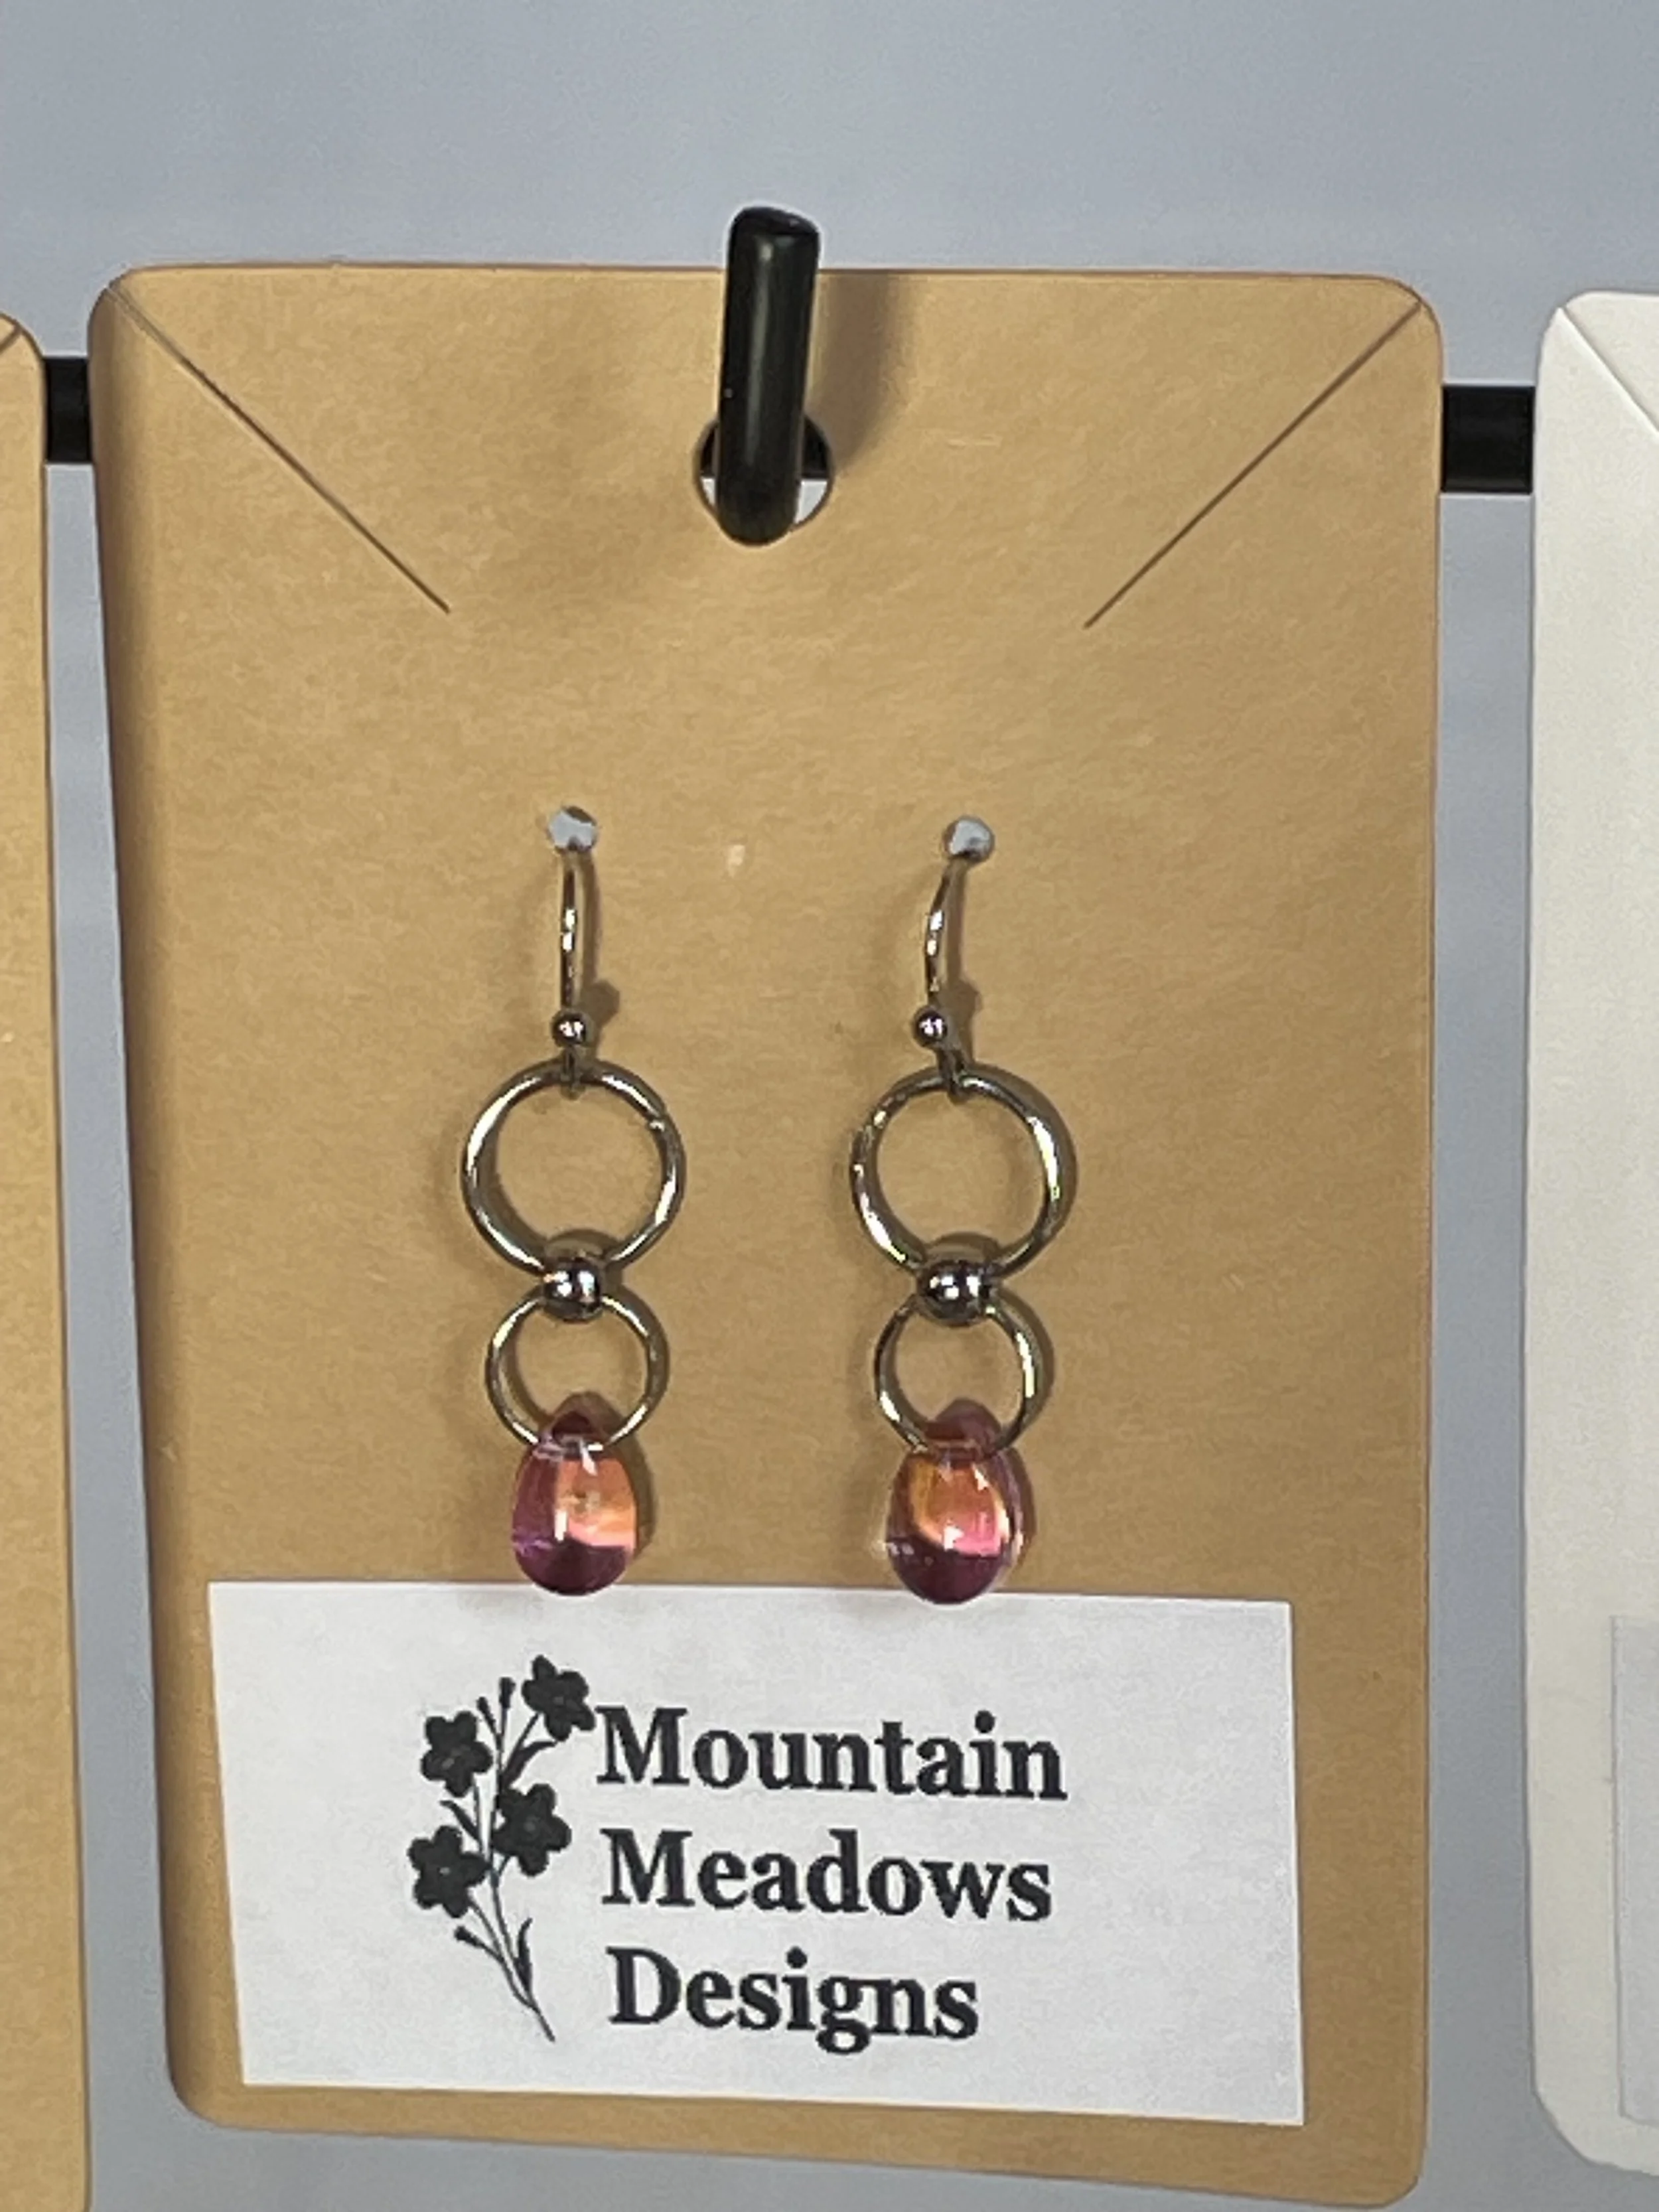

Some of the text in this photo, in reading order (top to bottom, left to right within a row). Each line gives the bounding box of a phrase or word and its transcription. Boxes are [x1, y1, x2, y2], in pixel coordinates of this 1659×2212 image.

[595, 1706, 1068, 1801] Mountain
[601, 1828, 1051, 1921] Meadows
[607, 1947, 978, 2055] Designs
